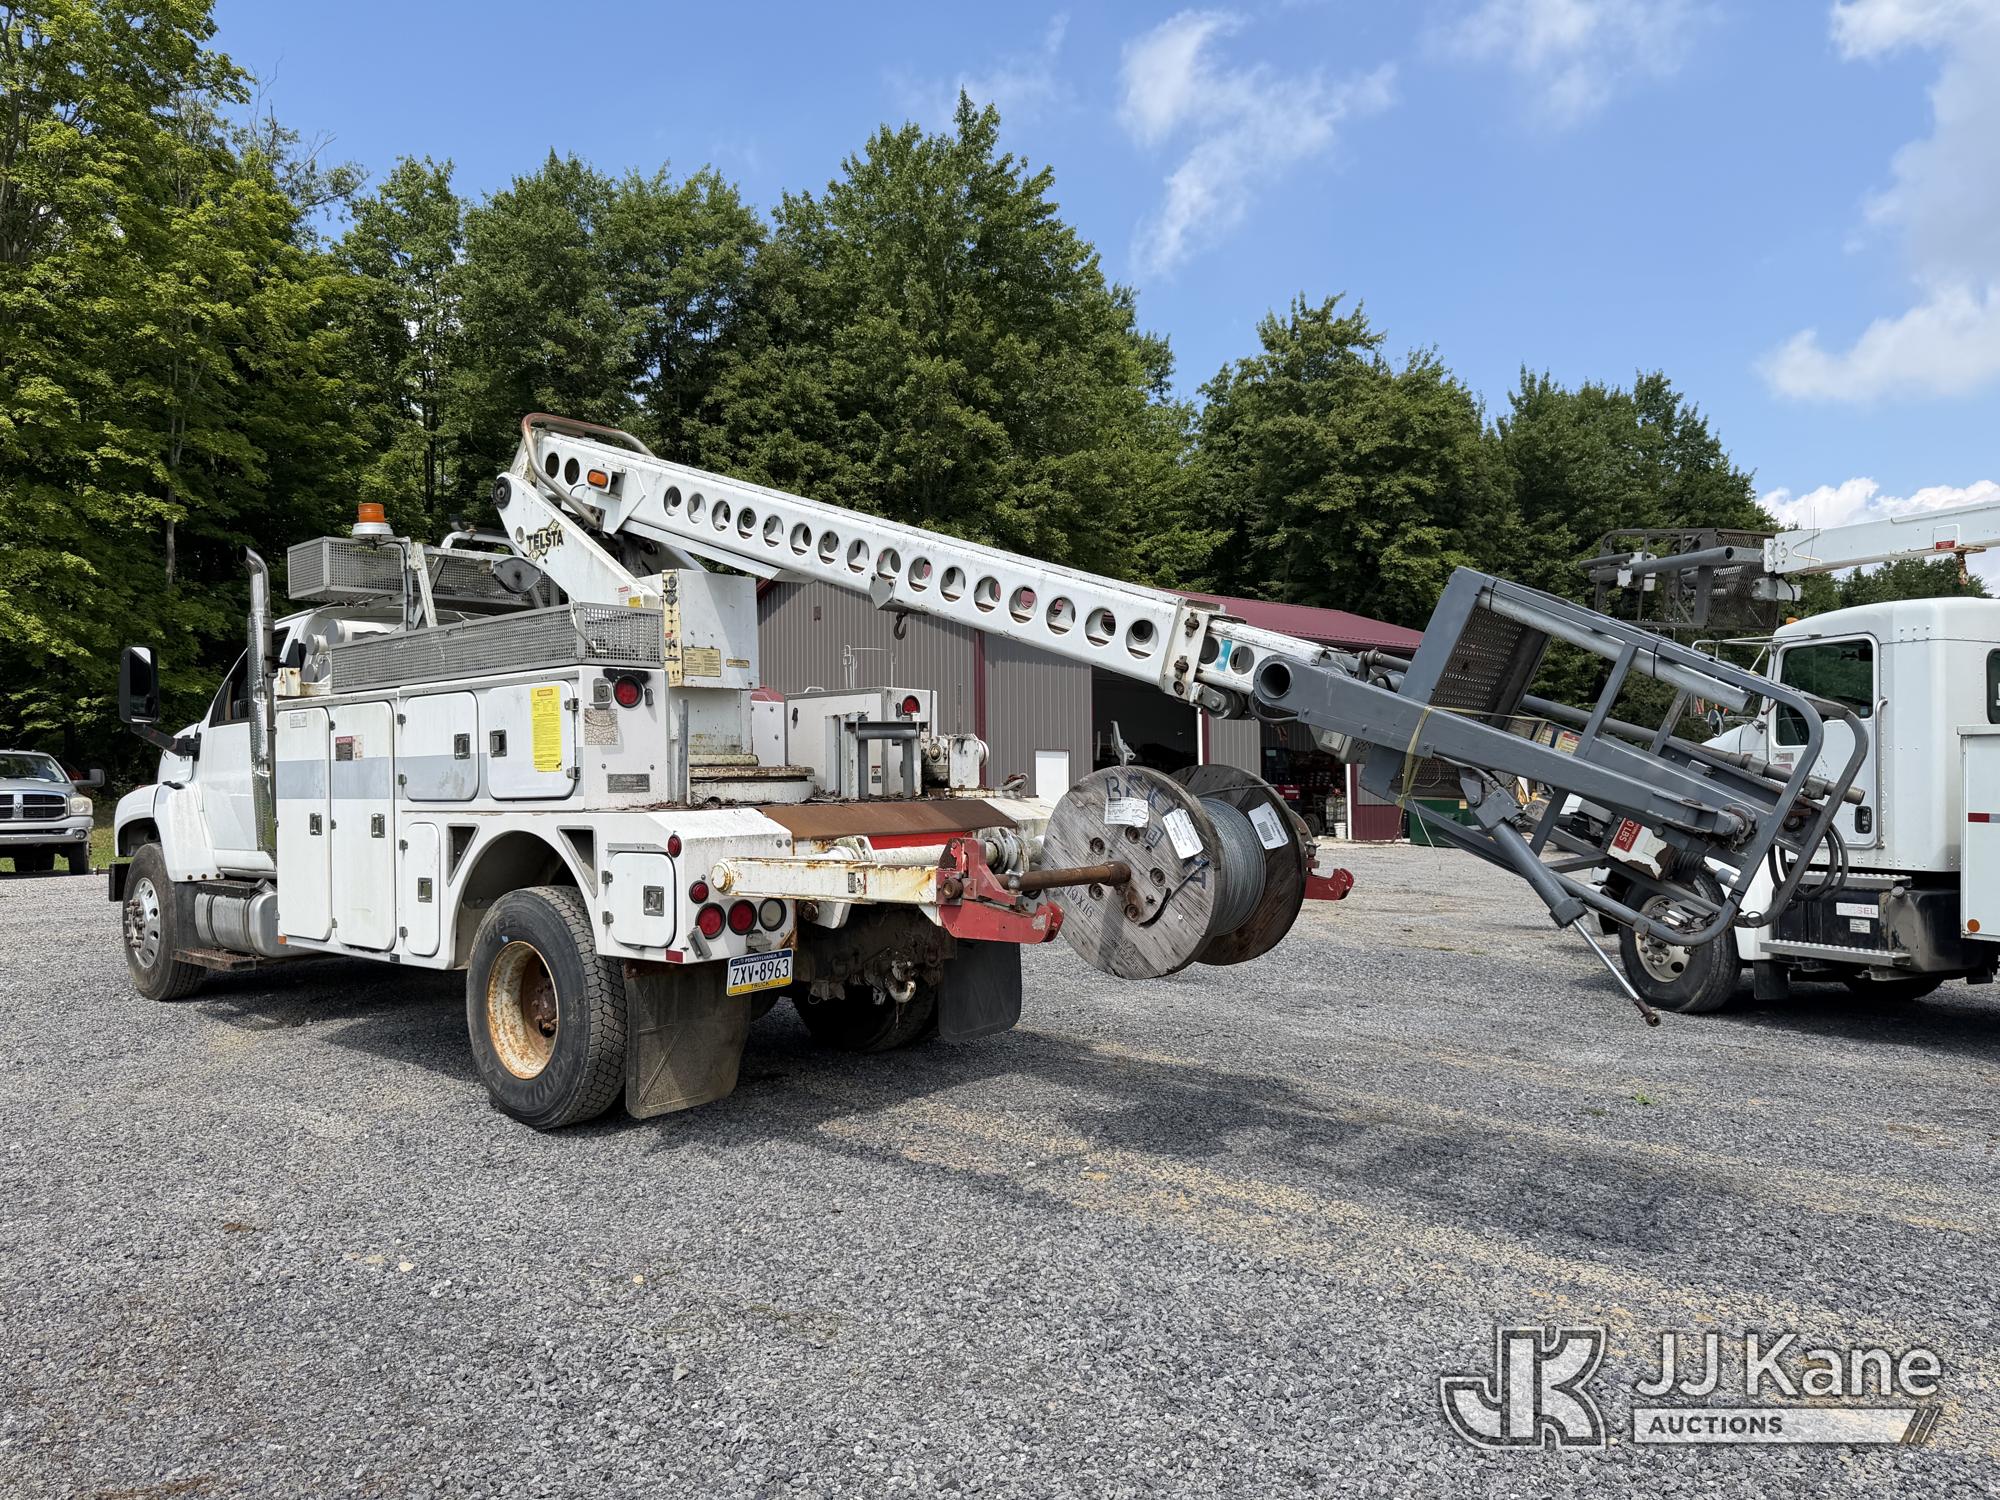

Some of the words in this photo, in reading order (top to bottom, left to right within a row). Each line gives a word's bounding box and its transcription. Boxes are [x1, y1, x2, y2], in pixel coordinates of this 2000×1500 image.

[526, 529, 564, 550] TELSTA
[1619, 826, 1632, 842] LBS
[744, 953, 778, 963] PENNSYLVANIA
